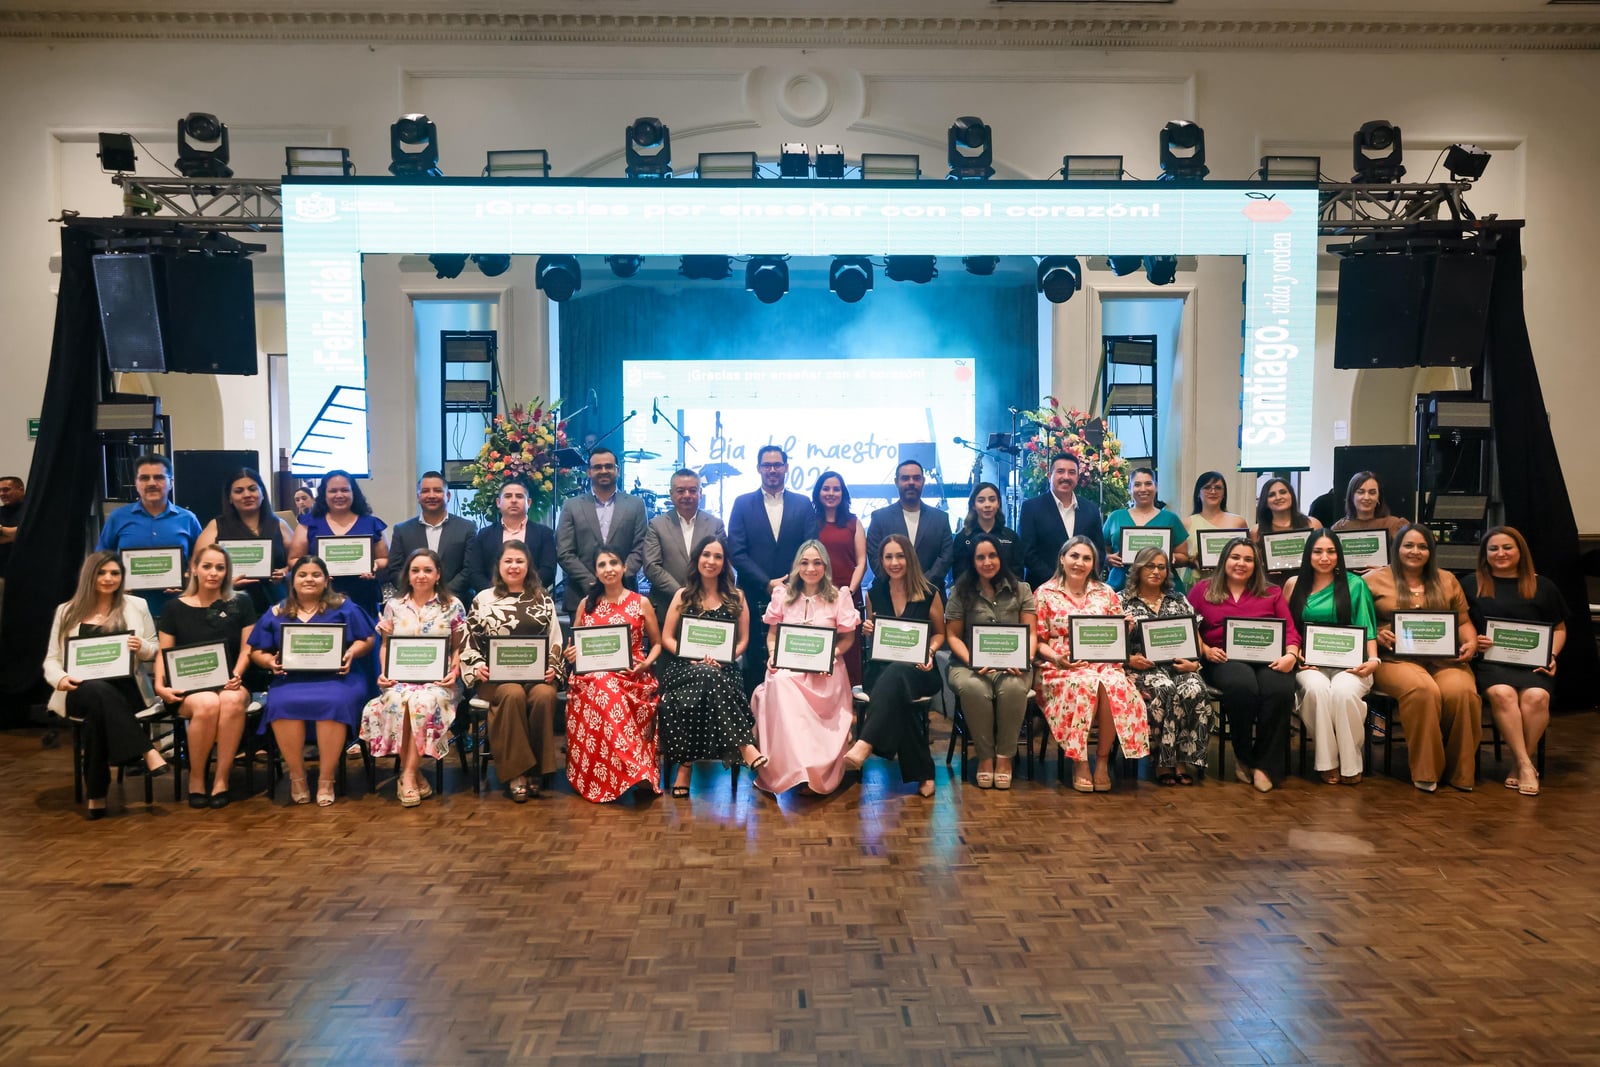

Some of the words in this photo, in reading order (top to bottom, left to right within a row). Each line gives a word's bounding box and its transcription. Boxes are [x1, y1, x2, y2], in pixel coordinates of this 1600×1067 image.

[643, 203, 706, 219] por
[719, 201, 866, 217] enseñar
[880, 204, 947, 217] con
[960, 202, 992, 217] el
[1006, 201, 1160, 217] corazón!
[1264, 232, 1292, 272] orden
[1264, 285, 1291, 314] vida
[1241, 318, 1299, 445] Santiago.
[807, 432, 898, 464] maestro
